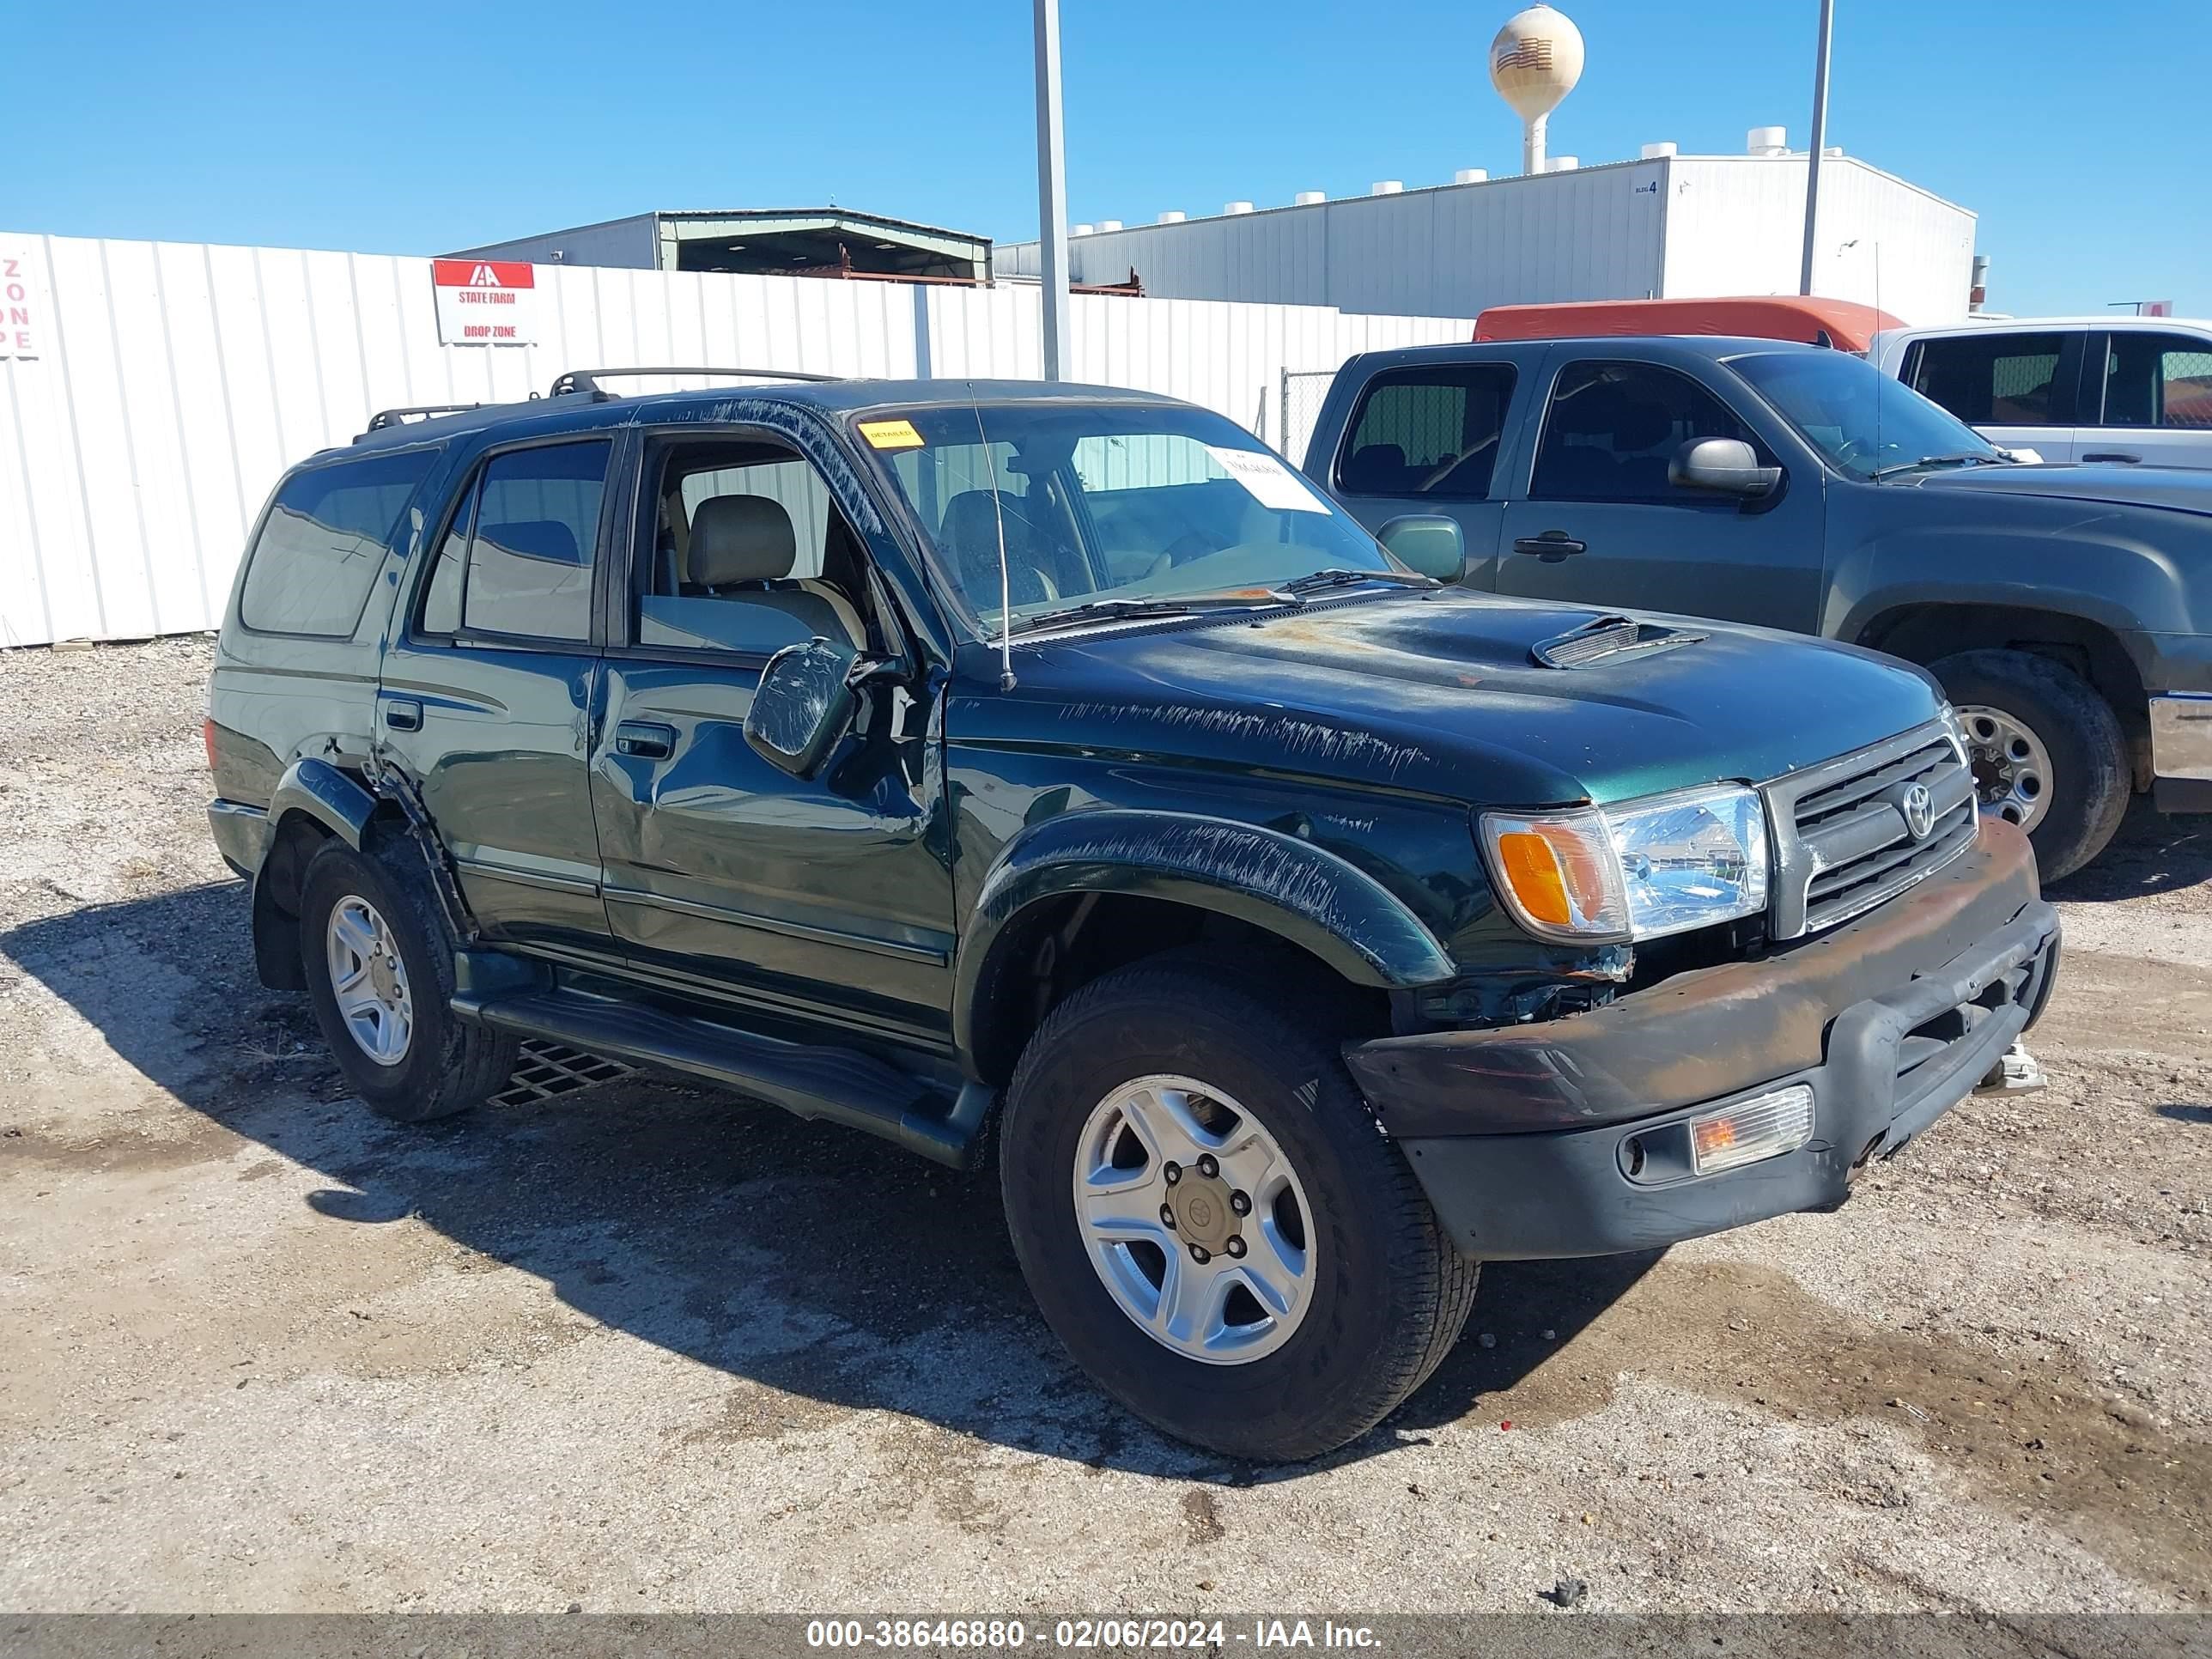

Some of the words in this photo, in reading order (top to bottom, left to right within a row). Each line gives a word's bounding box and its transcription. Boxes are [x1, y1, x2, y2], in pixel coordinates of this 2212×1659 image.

[1650, 181, 1656, 193] 4
[459, 292, 488, 303] STATE
[489, 293, 515, 304] FARM
[464, 325, 491, 337] DROP
[492, 326, 516, 337] ZONE
